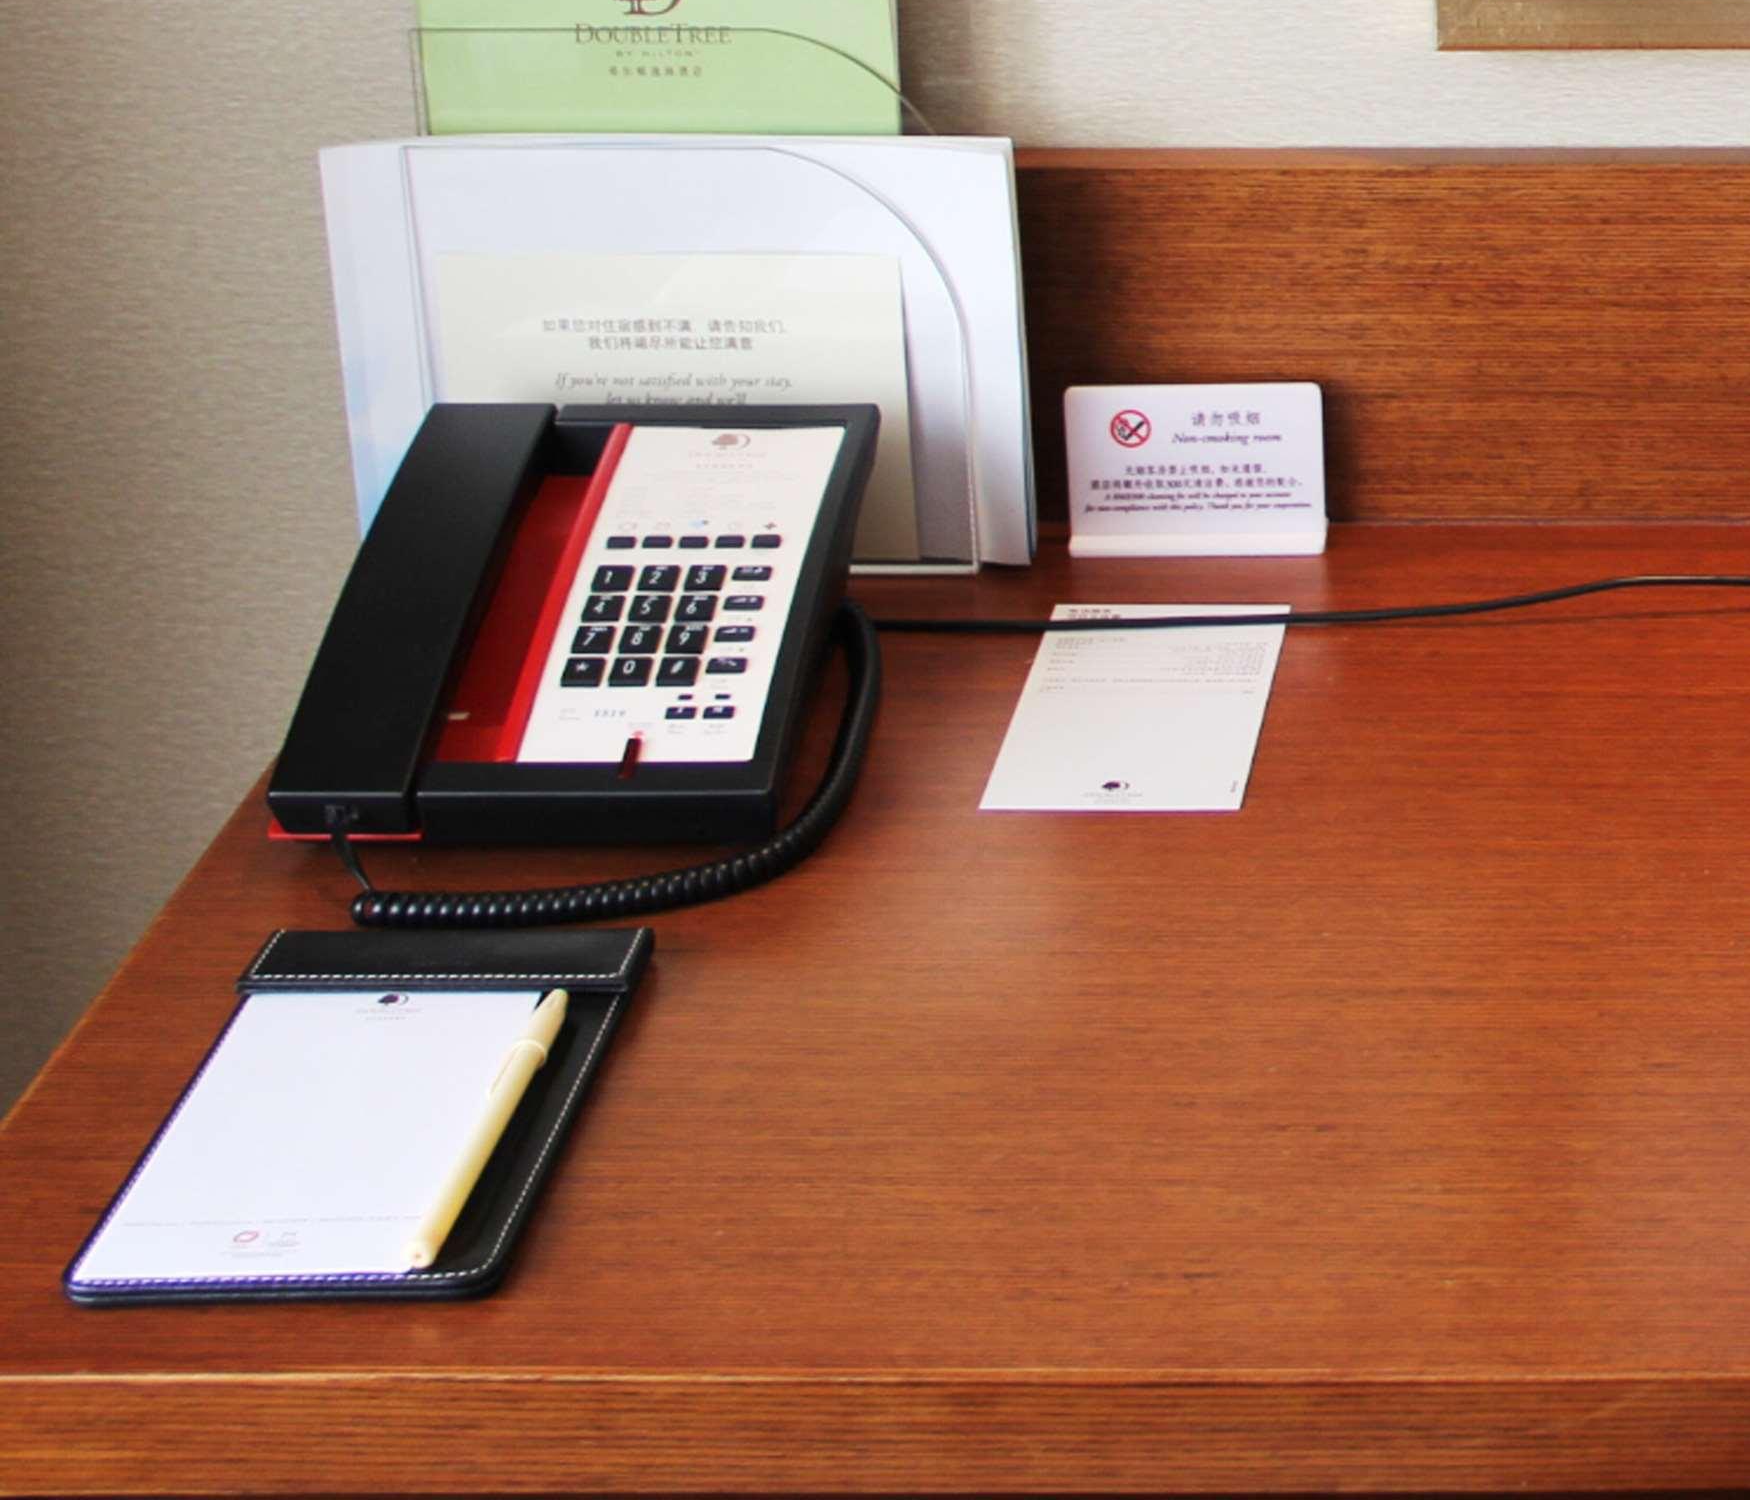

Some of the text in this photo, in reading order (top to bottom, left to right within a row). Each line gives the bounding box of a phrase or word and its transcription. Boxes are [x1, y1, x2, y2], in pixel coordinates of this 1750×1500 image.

[604, 570, 707, 584] 1 2 3
[594, 601, 697, 614] 4 5 6
[583, 632, 690, 645] 7 8 9
[623, 660, 636, 674] 0
